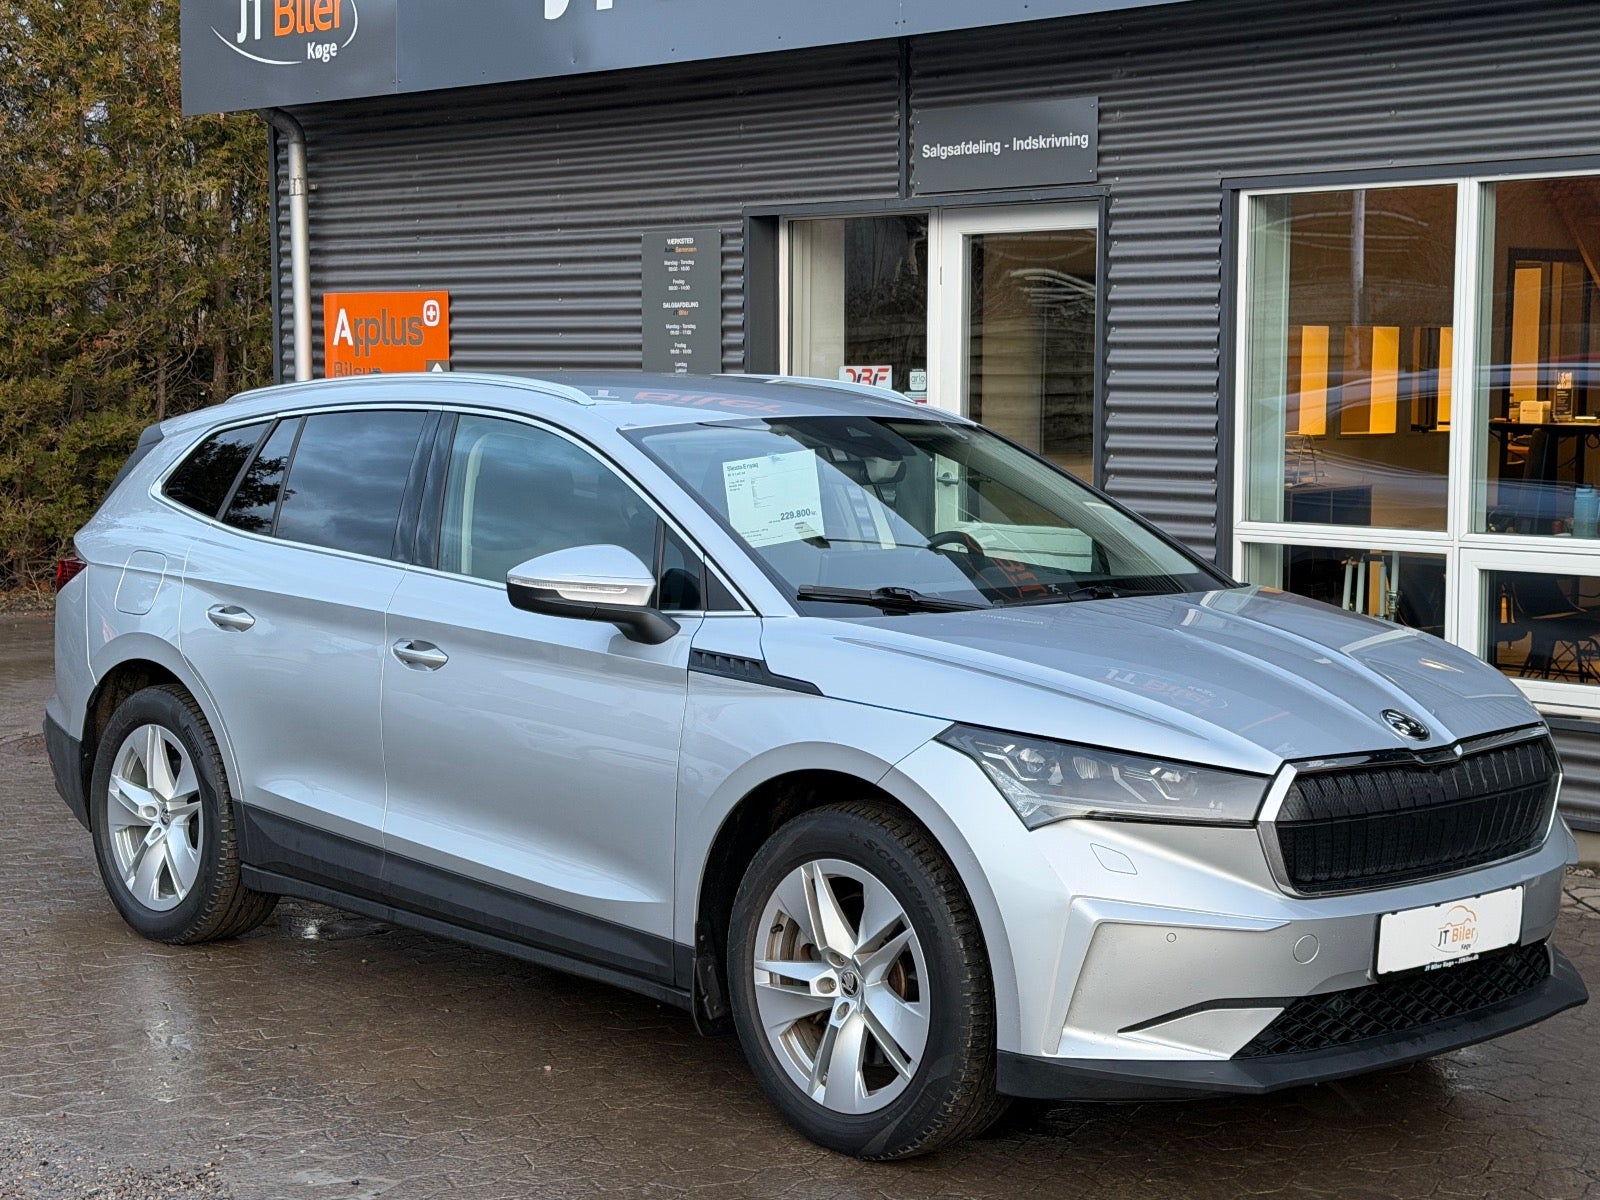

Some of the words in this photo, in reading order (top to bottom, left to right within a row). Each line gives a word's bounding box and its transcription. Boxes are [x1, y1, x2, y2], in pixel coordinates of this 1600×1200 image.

[237, 0, 261, 43] JT
[274, 0, 341, 37] Biler
[307, 42, 337, 62] Køge
[922, 139, 1001, 160] Salgsafdeling
[1013, 132, 1089, 151] Indskrivning
[780, 508, 811, 521] 229.800
[1438, 929, 1449, 947] JT
[1452, 926, 1475, 942] Biler
